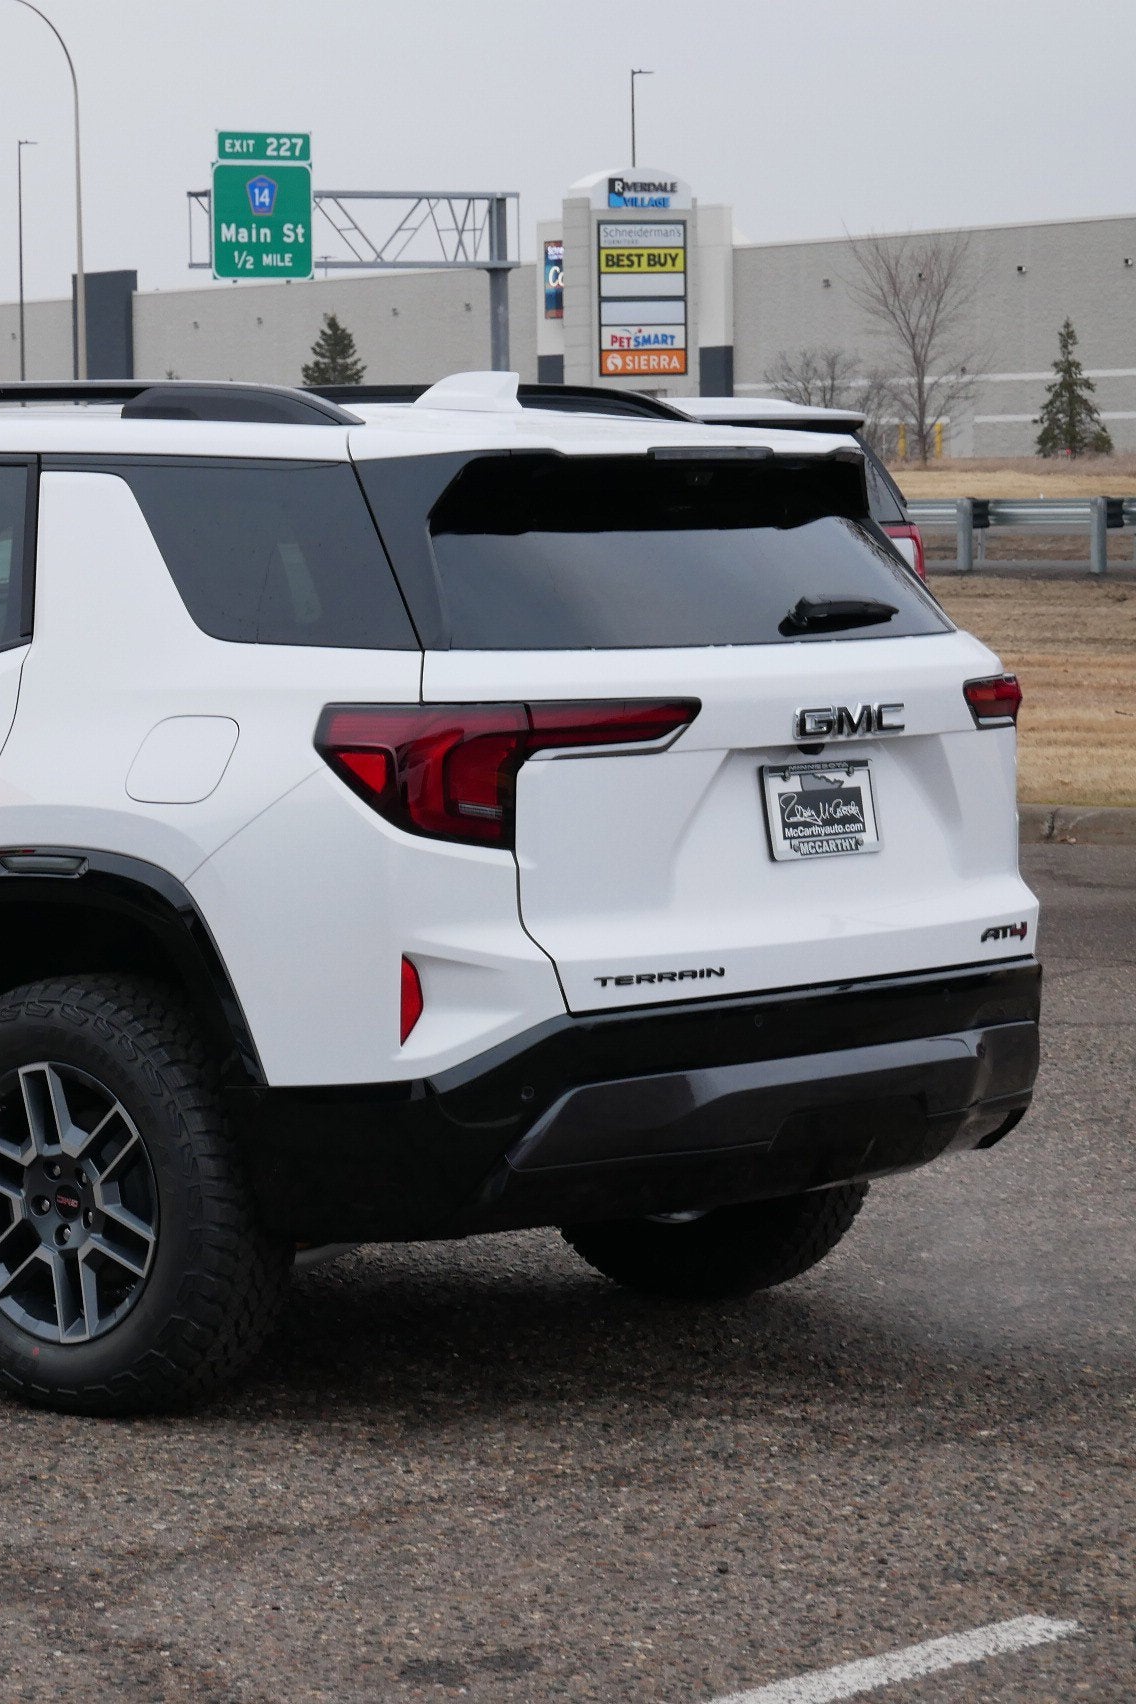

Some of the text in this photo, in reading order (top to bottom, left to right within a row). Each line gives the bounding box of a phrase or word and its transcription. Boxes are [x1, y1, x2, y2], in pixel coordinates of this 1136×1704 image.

[224, 137, 304, 157] EXIT 227
[614, 180, 678, 194] RIVERDALE
[254, 187, 270, 206] 14
[623, 196, 671, 208] VILLAGE
[220, 222, 306, 243] Main St
[603, 226, 682, 239] Schneiderman's
[234, 250, 293, 269] 1/2 MILE
[605, 252, 680, 269] BEST BUY
[625, 355, 680, 370] SIERRA
[792, 702, 905, 740] GMC
[785, 822, 863, 838] McCarthyauto.com
[800, 838, 857, 855] MCCARTHY
[981, 921, 1028, 943] AT4
[593, 966, 726, 988] TERRAIN
